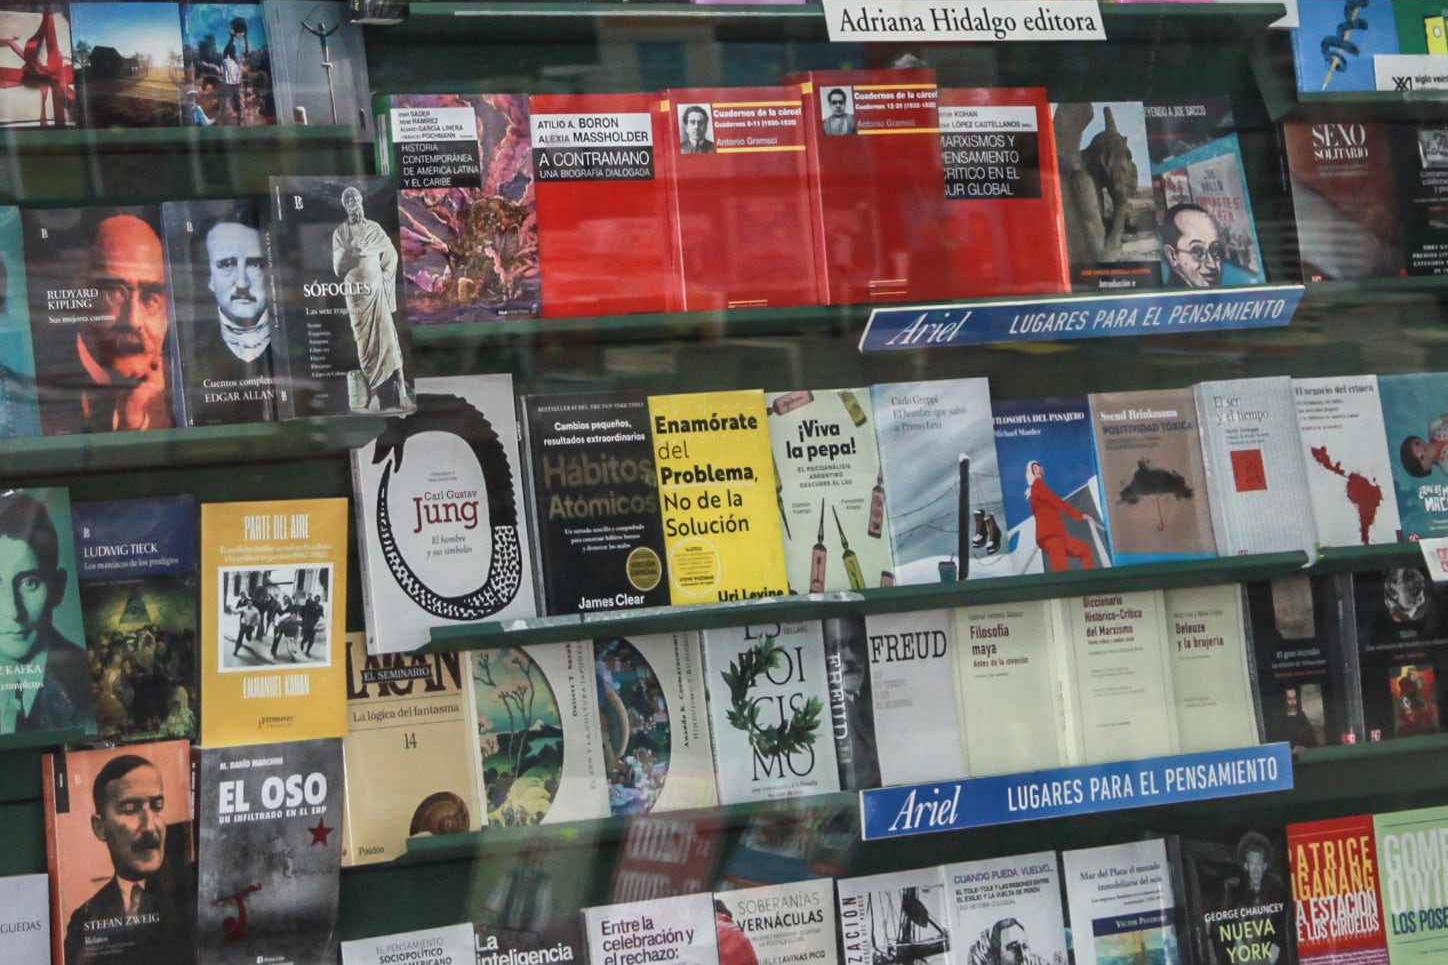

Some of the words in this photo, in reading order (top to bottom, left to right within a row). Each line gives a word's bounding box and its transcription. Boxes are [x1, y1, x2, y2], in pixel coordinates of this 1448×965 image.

[840, 7, 925, 32] Adriana
[927, 7, 1016, 39] Hidalgo
[1024, 8, 1096, 31] editora
[579, 117, 618, 128] BORON
[573, 132, 648, 142] MASSHOLDER
[554, 151, 649, 165] CONTRAMANO
[47, 289, 98, 299] RUDYARD
[304, 280, 371, 297] SÓFOCLES
[48, 299, 92, 310] KIPLING
[886, 311, 972, 346] Ariel
[1009, 311, 1087, 334] LUGARES
[1094, 307, 1136, 329] PARA
[1142, 306, 1161, 326] EL
[1168, 299, 1286, 325] PENSAMIENTO
[554, 421, 589, 431] Cambios
[655, 413, 758, 434] Enamórate
[799, 420, 840, 442] ¡Viva
[544, 434, 584, 445] resultados
[586, 432, 645, 443] extraordinarios
[787, 441, 803, 459] la
[807, 437, 856, 460] pepa!
[659, 440, 689, 459] del
[661, 465, 758, 485] Problema,
[424, 491, 443, 500] Carl
[446, 490, 477, 499] Gustav
[665, 493, 691, 511] No
[700, 491, 721, 508] de
[728, 490, 743, 507] la
[413, 497, 478, 533] Jung
[245, 515, 271, 539] PARTE
[274, 516, 288, 538] DEL
[291, 514, 309, 538] AIRE
[667, 515, 749, 537] Solución
[84, 544, 128, 557] LUDWIG
[131, 543, 157, 554] TIECK
[579, 596, 613, 609] James
[616, 594, 645, 605] Clear
[870, 632, 947, 663] FREUD
[219, 781, 249, 814] EL
[262, 773, 327, 809] OSO
[888, 786, 961, 832] Ariel
[1008, 779, 1083, 812] LUGARES
[1091, 771, 1133, 802] PARA
[1141, 769, 1159, 795] EL
[1166, 758, 1277, 790] PENSAMIENTO
[84, 920, 123, 931] STEFAN
[126, 913, 159, 925] ZWEIG
[1220, 920, 1275, 941] NUEVA
[1227, 942, 1271, 963] YORK
